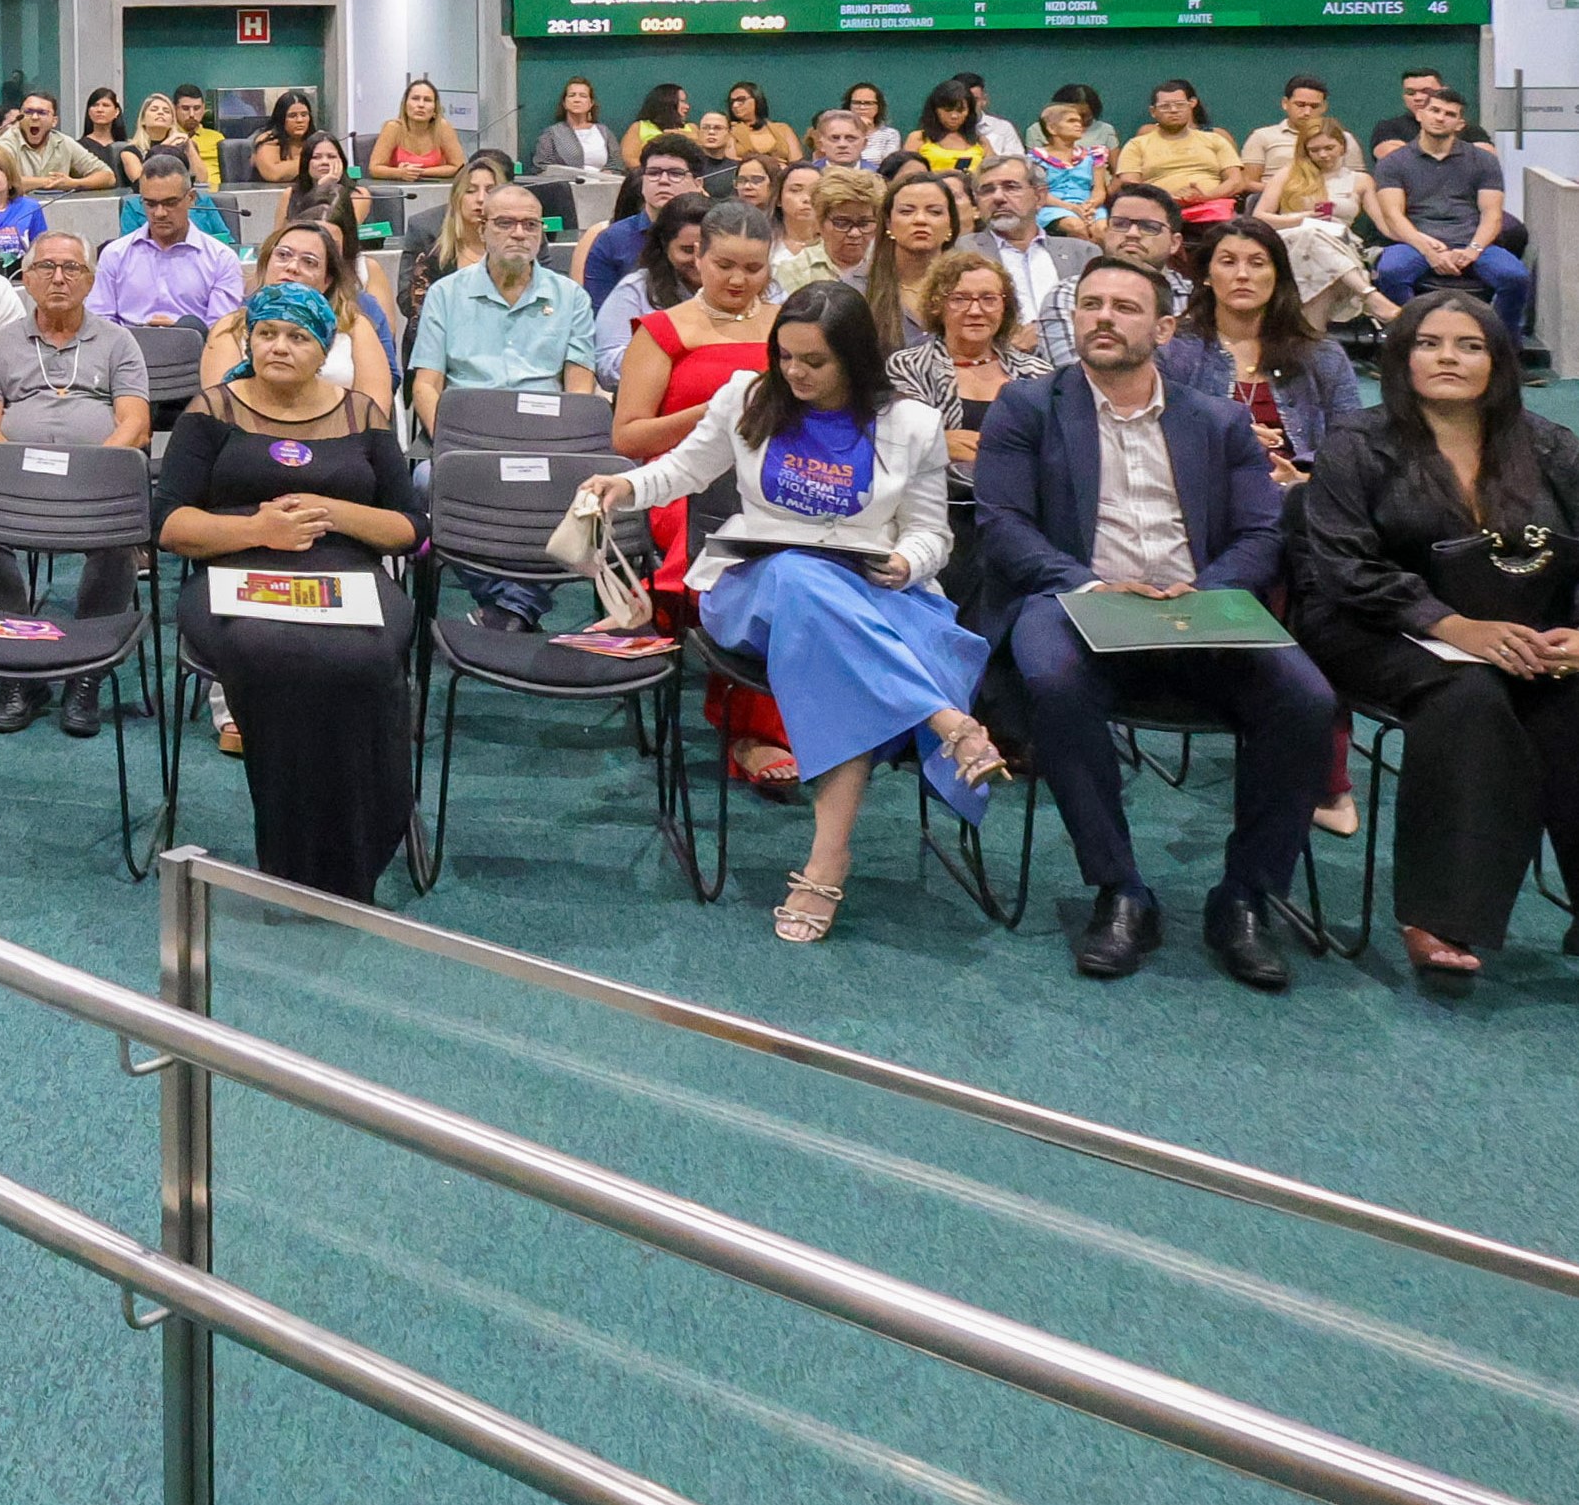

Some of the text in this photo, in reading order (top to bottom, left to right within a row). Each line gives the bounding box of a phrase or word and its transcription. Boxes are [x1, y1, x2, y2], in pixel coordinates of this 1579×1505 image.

[1323, 1, 1448, 15] AUSENTES 46
[245, 17, 262, 36] H
[640, 18, 685, 31] 00:00
[783, 454, 853, 477] 21 DIAS
[777, 477, 849, 507] VIOLÊNCIA
[806, 480, 835, 494] FIM
[774, 495, 783, 504] A
